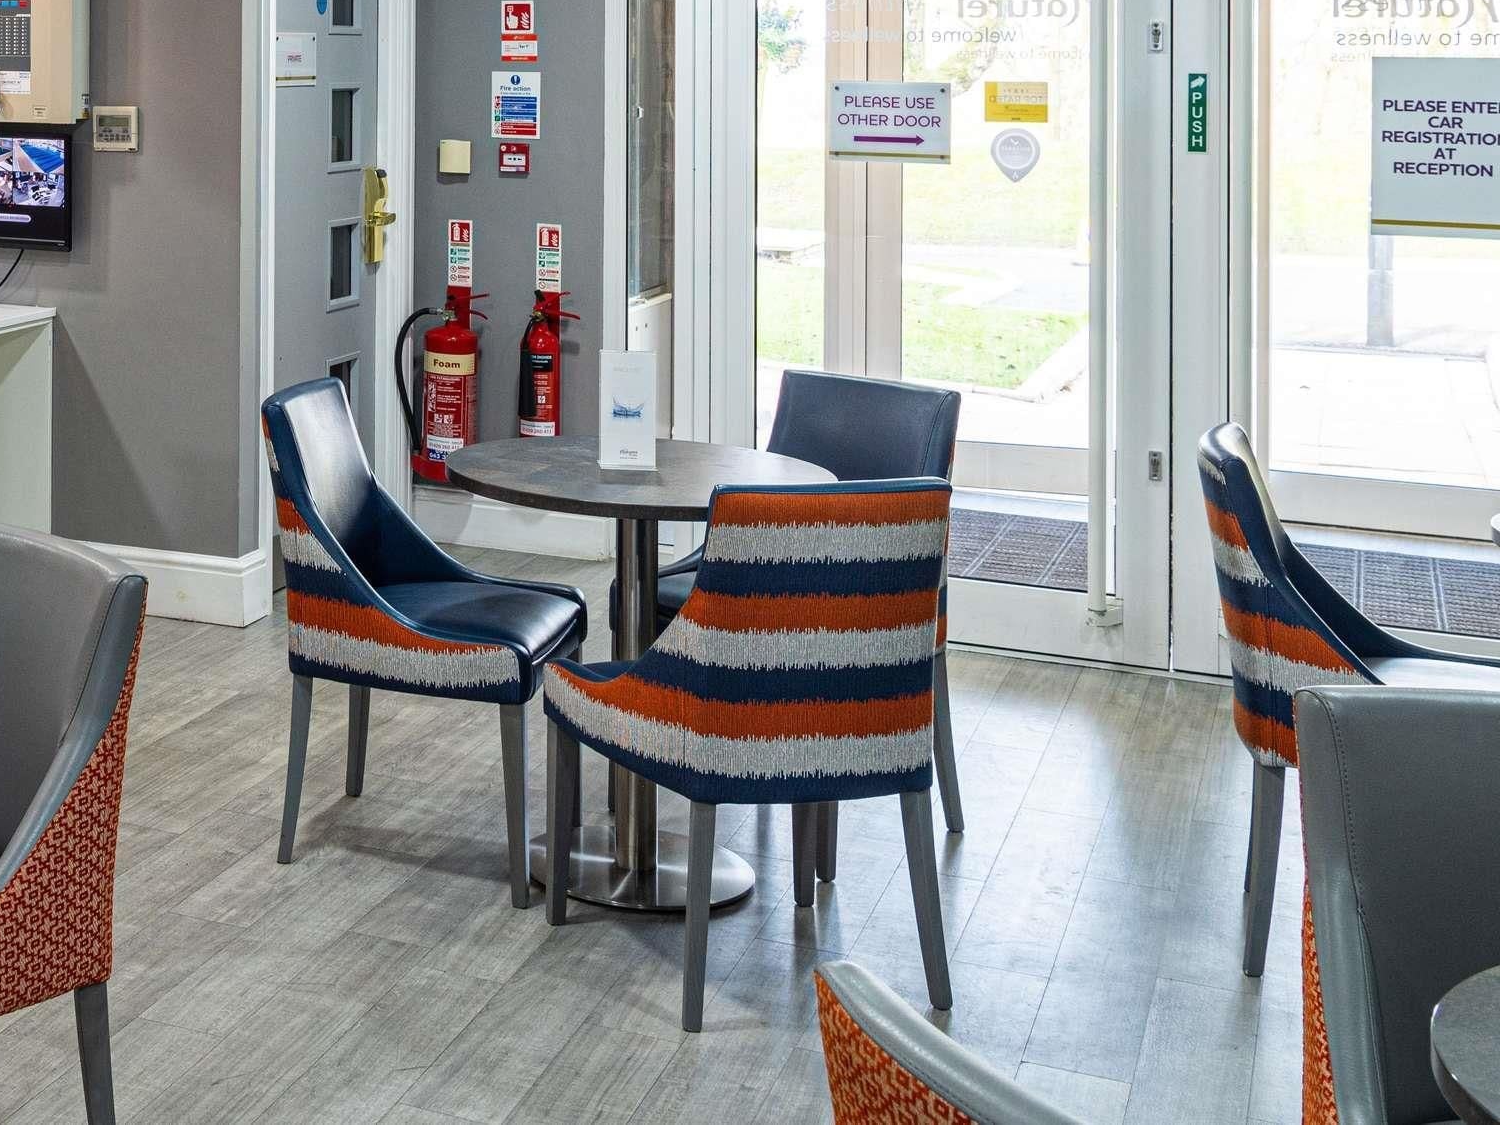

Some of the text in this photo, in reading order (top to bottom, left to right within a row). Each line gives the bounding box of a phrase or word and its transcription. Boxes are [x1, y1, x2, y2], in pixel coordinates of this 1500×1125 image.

[844, 96, 935, 110] PLEASE USE
[1383, 99, 1447, 113] PLEASE
[837, 113, 941, 127] OTHER DOOR
[1191, 91, 1203, 147] PUSH
[1428, 116, 1463, 128] CAR
[1434, 147, 1457, 160] AT
[1393, 161, 1493, 177] RECEPTION
[433, 358, 461, 369] Foam
